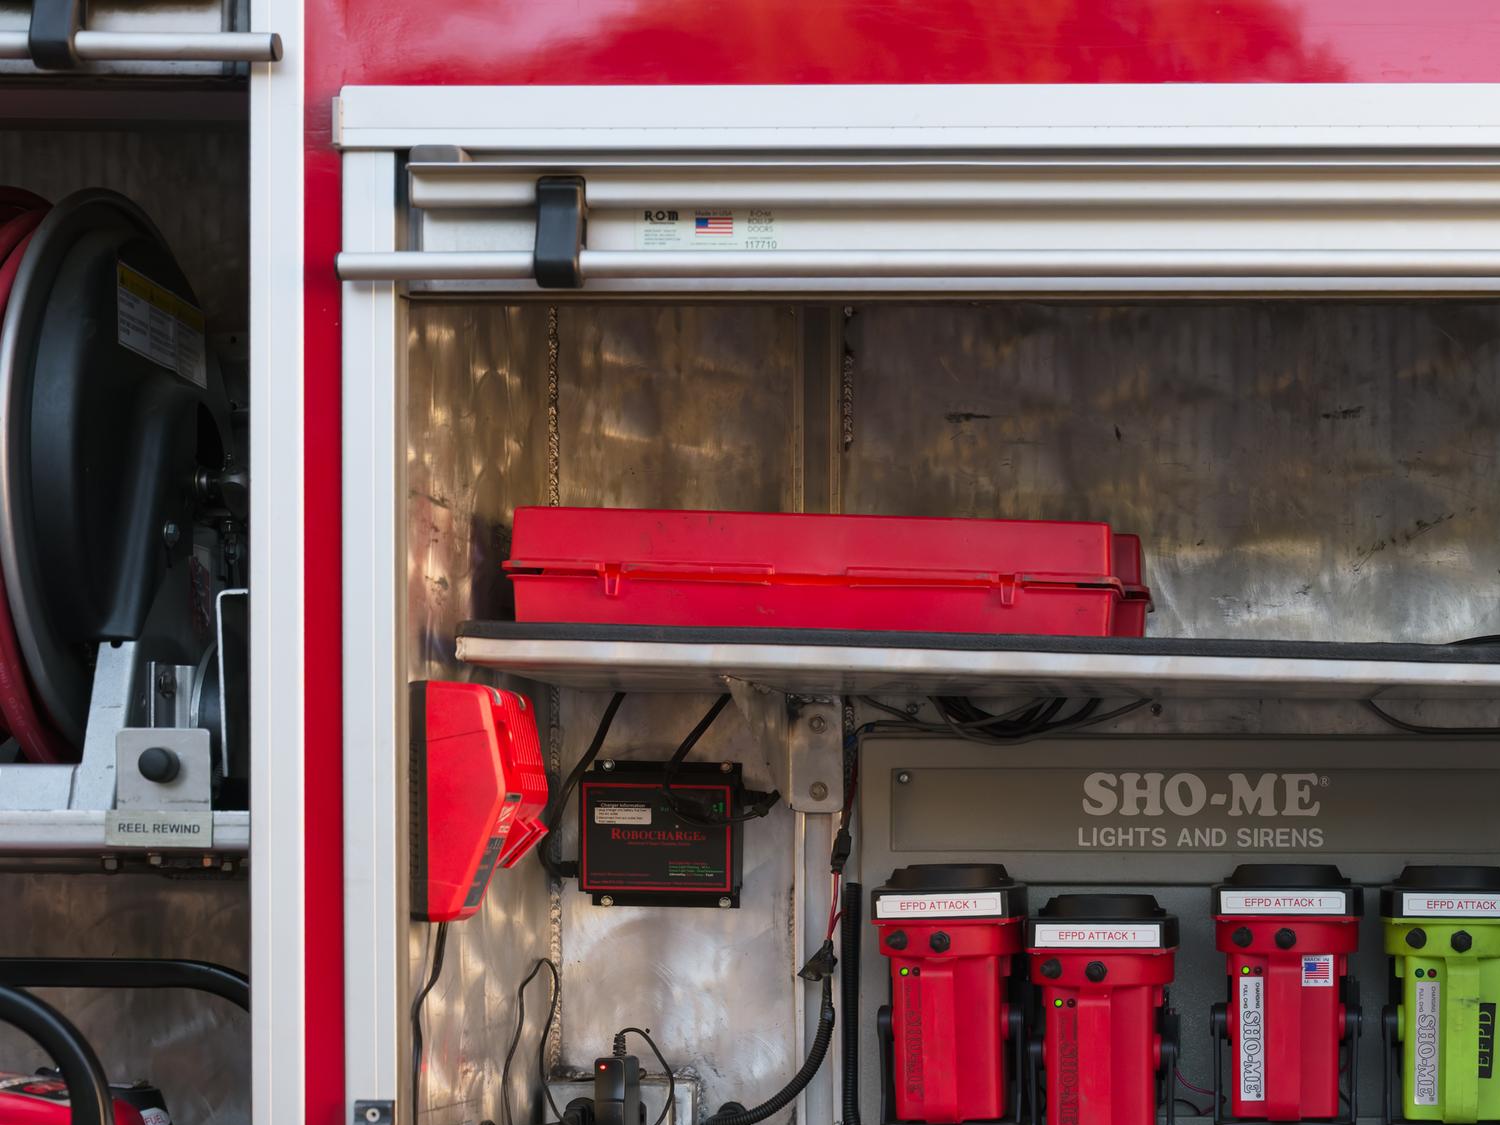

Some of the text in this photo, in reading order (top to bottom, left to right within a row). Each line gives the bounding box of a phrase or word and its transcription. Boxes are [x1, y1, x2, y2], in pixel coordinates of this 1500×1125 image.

[747, 225, 774, 233] DOORS
[1082, 771, 1321, 817] SHO-ME
[118, 823, 200, 834] REEL REWIND
[1078, 827, 1324, 848] LIGHTS AND SIRENS
[900, 901, 927, 911] EFPD
[929, 901, 970, 911] ATTACK
[1244, 898, 1272, 907] EFPD
[1274, 898, 1314, 907] ATTACK
[1426, 901, 1454, 910] EFPD
[1457, 901, 1497, 910] ATTACK
[1058, 931, 1085, 940] EFPD
[1088, 931, 1129, 940] ATTACK
[1478, 1011, 1492, 1068] EFPD
